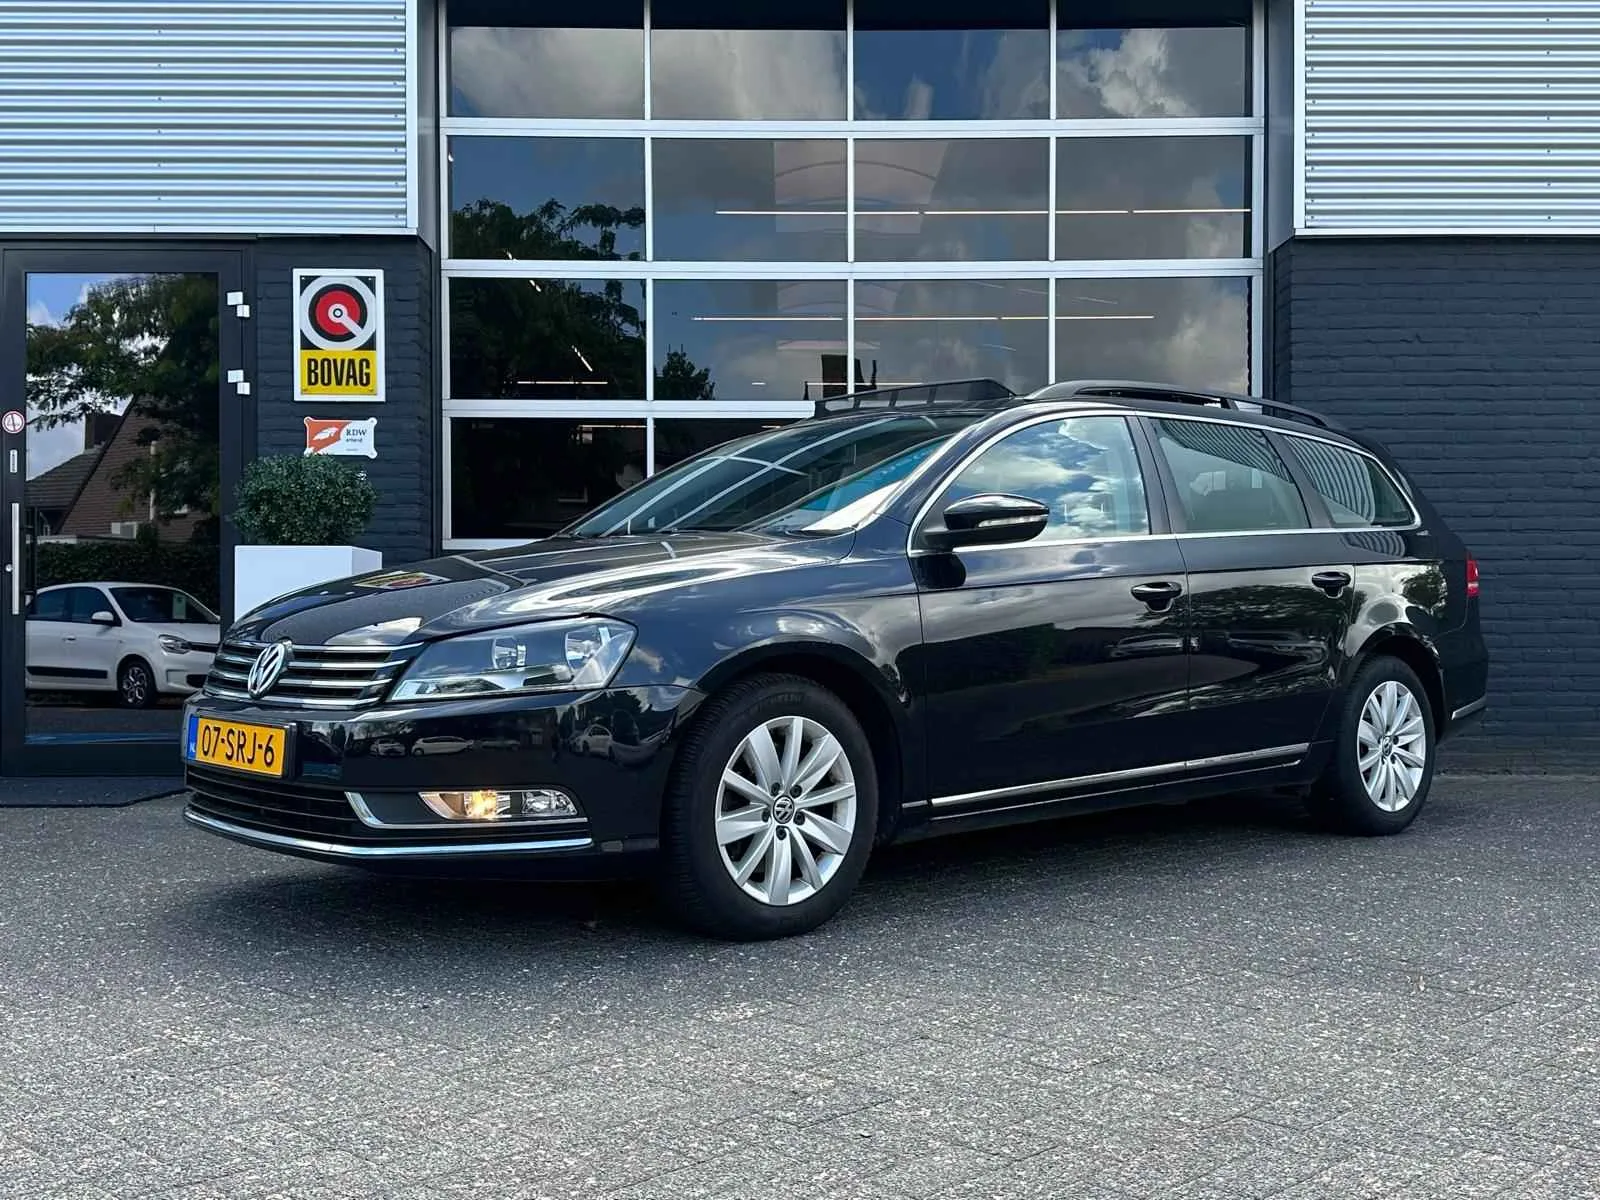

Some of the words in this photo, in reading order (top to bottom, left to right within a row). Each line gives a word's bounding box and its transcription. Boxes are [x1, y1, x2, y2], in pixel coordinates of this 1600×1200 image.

[307, 358, 371, 386] BOVAG
[345, 428, 368, 436] RDW
[201, 724, 276, 768] 07-SRJ-6
